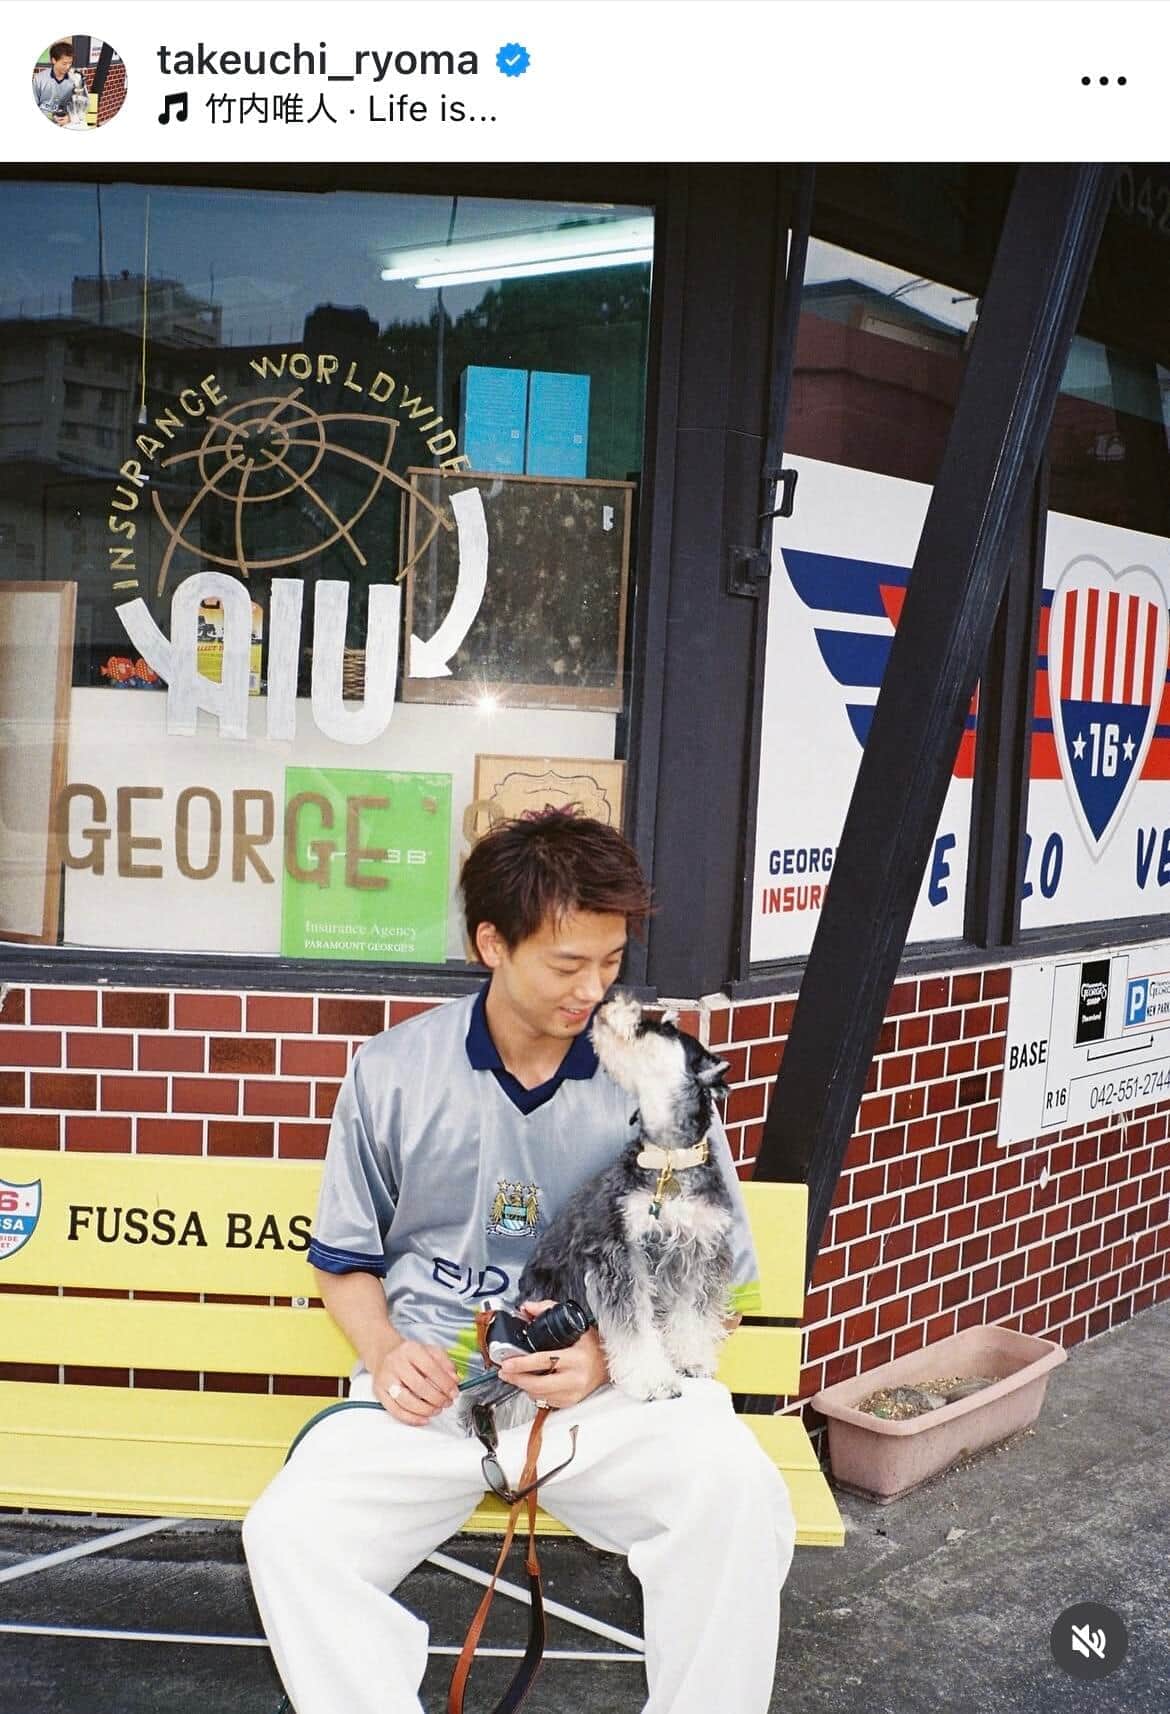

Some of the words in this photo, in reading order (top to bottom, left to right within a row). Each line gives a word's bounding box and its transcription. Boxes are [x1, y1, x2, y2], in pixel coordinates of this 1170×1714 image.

[109, 374, 228, 590] INSURANCE
[250, 353, 472, 478] WORLDWIDE
[116, 571, 401, 745] AIU
[1090, 723, 1119, 778] 16
[769, 847, 833, 875] GEORG
[1009, 1040, 1048, 1070] BASE
[1090, 1069, 1170, 1109] 042-551-2744
[0, 1218, 24, 1231] SA
[67, 1205, 208, 1247] FUSSA
[226, 1213, 312, 1251] BAS
